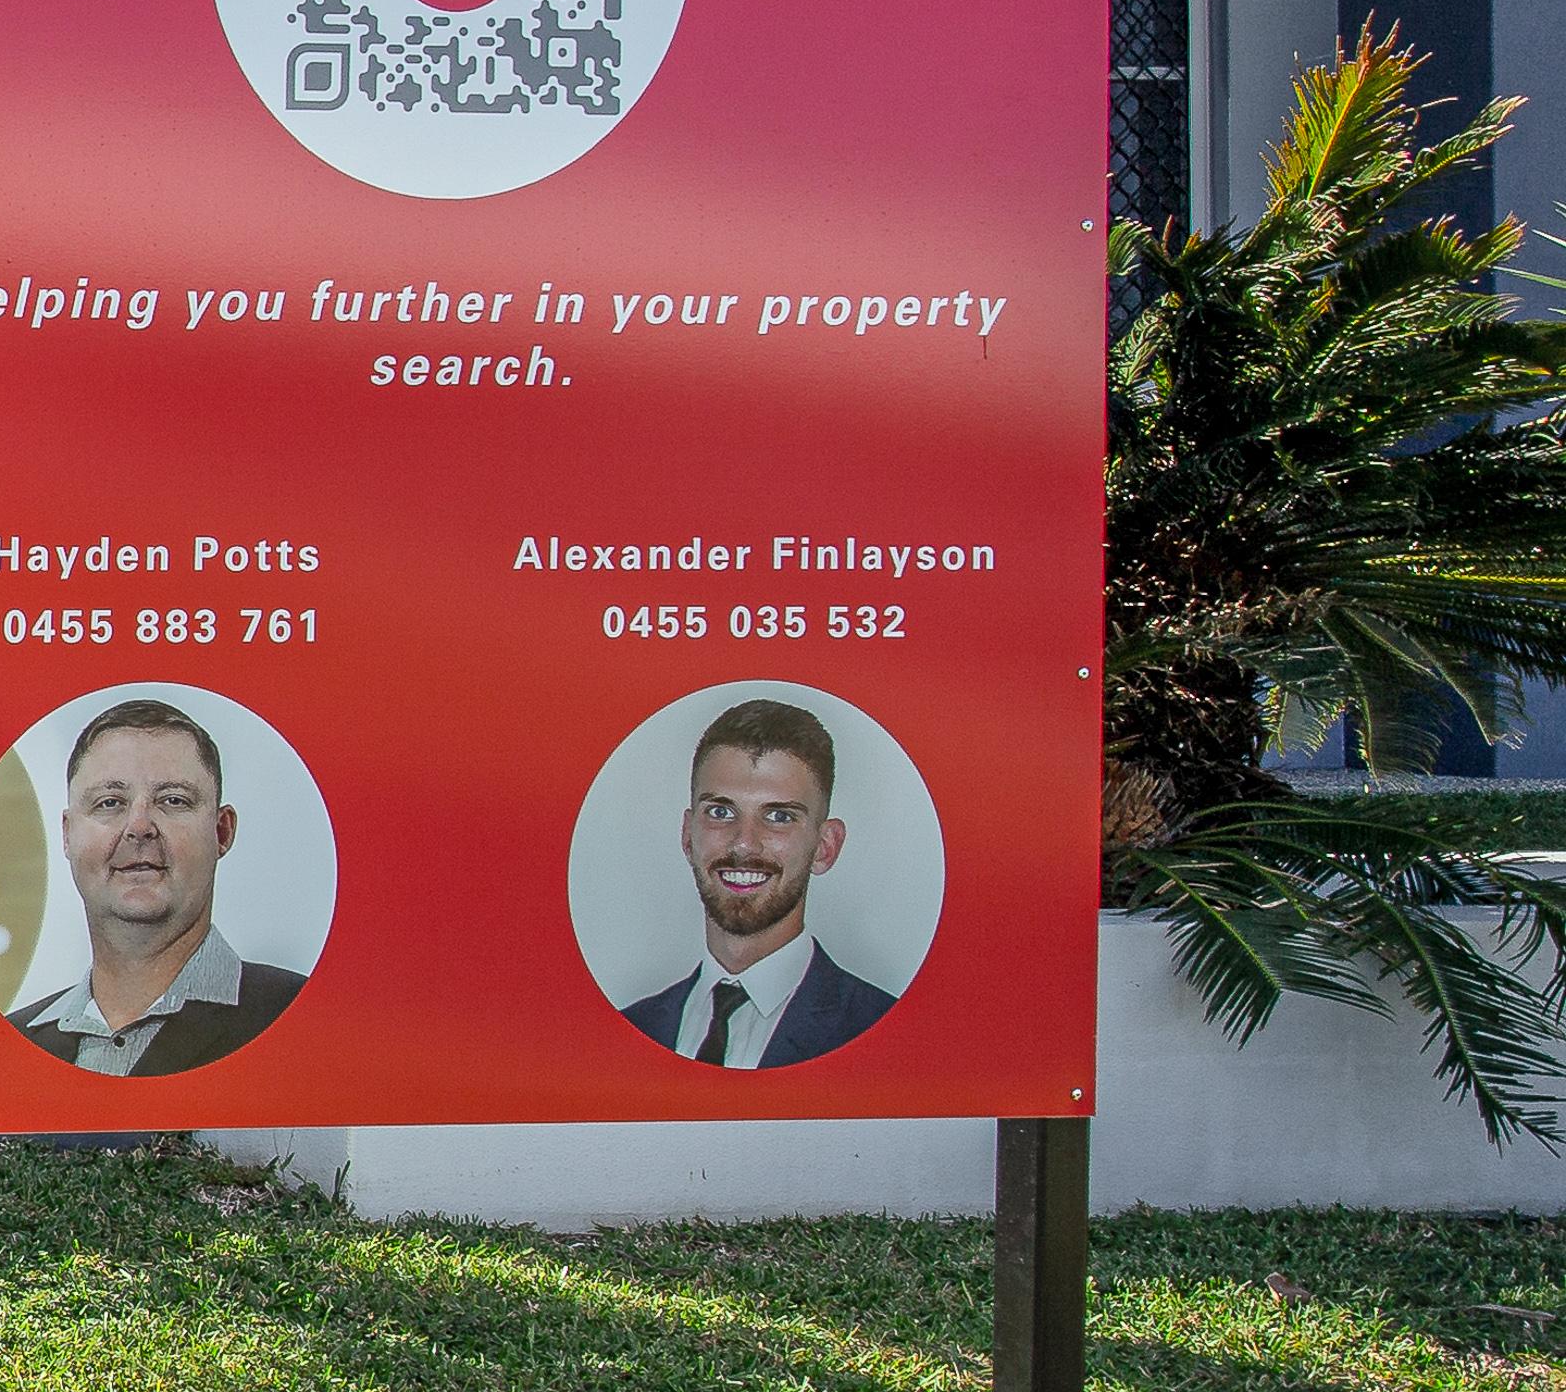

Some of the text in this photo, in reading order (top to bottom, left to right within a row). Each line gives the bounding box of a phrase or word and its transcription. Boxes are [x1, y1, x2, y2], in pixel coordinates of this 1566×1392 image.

[184, 289, 287, 331] you
[309, 278, 514, 324] further
[533, 281, 586, 324] in
[611, 293, 740, 335] your
[756, 289, 1008, 337] property
[369, 344, 572, 387] search.
[193, 535, 320, 573] Potts
[511, 535, 995, 579] Alexander Finlayson
[2, 607, 317, 645] 0455 883 761
[601, 604, 906, 640] 0455 035 532
